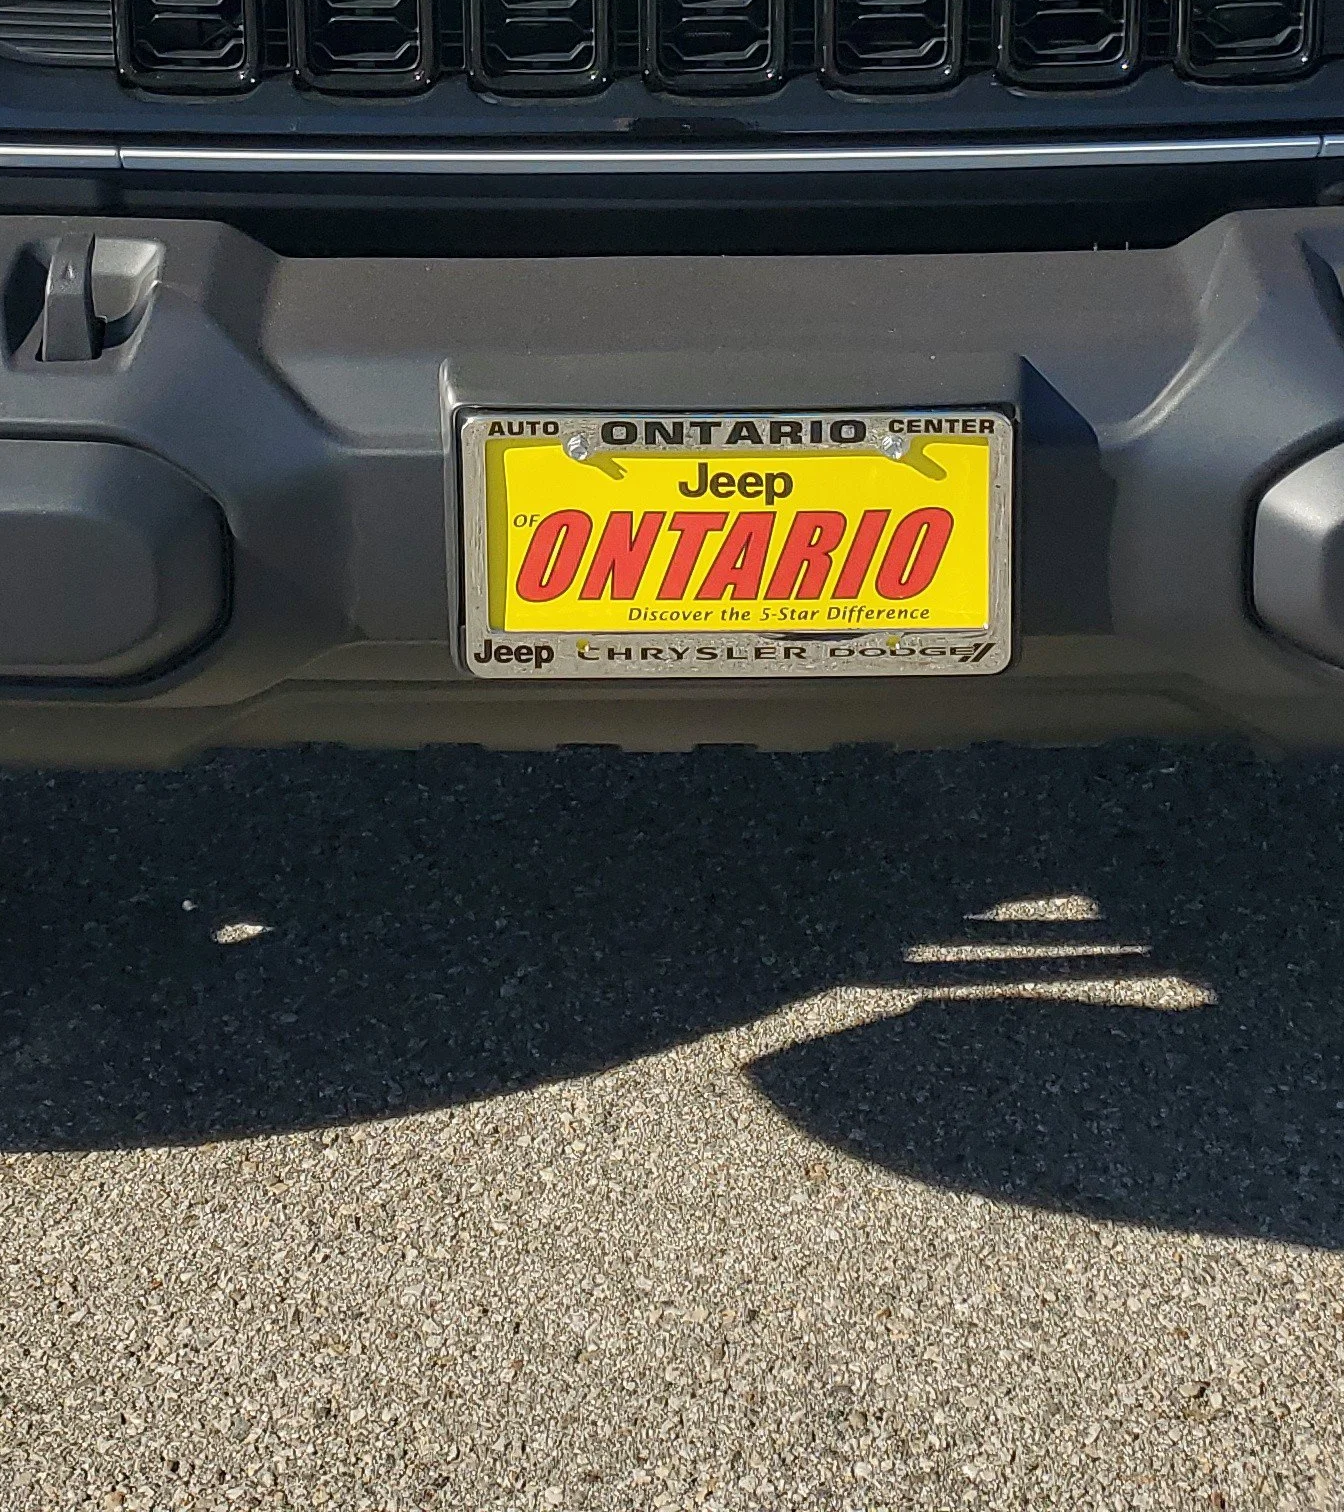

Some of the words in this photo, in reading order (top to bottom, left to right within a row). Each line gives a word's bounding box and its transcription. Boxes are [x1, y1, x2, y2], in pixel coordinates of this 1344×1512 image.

[488, 420, 559, 437] AUTO
[601, 419, 867, 446] ONTARIO
[888, 418, 996, 435] CENTER
[678, 462, 794, 506] Jeep
[514, 513, 541, 528] OF
[515, 507, 954, 602] ONTARIO
[628, 606, 716, 622] Discover
[721, 606, 751, 621] the
[760, 606, 820, 622] 5-Star
[826, 605, 931, 621] Difference
[473, 639, 554, 666] Jeep
[577, 645, 819, 661] CHRYSLER
[829, 644, 977, 659] DODGE
